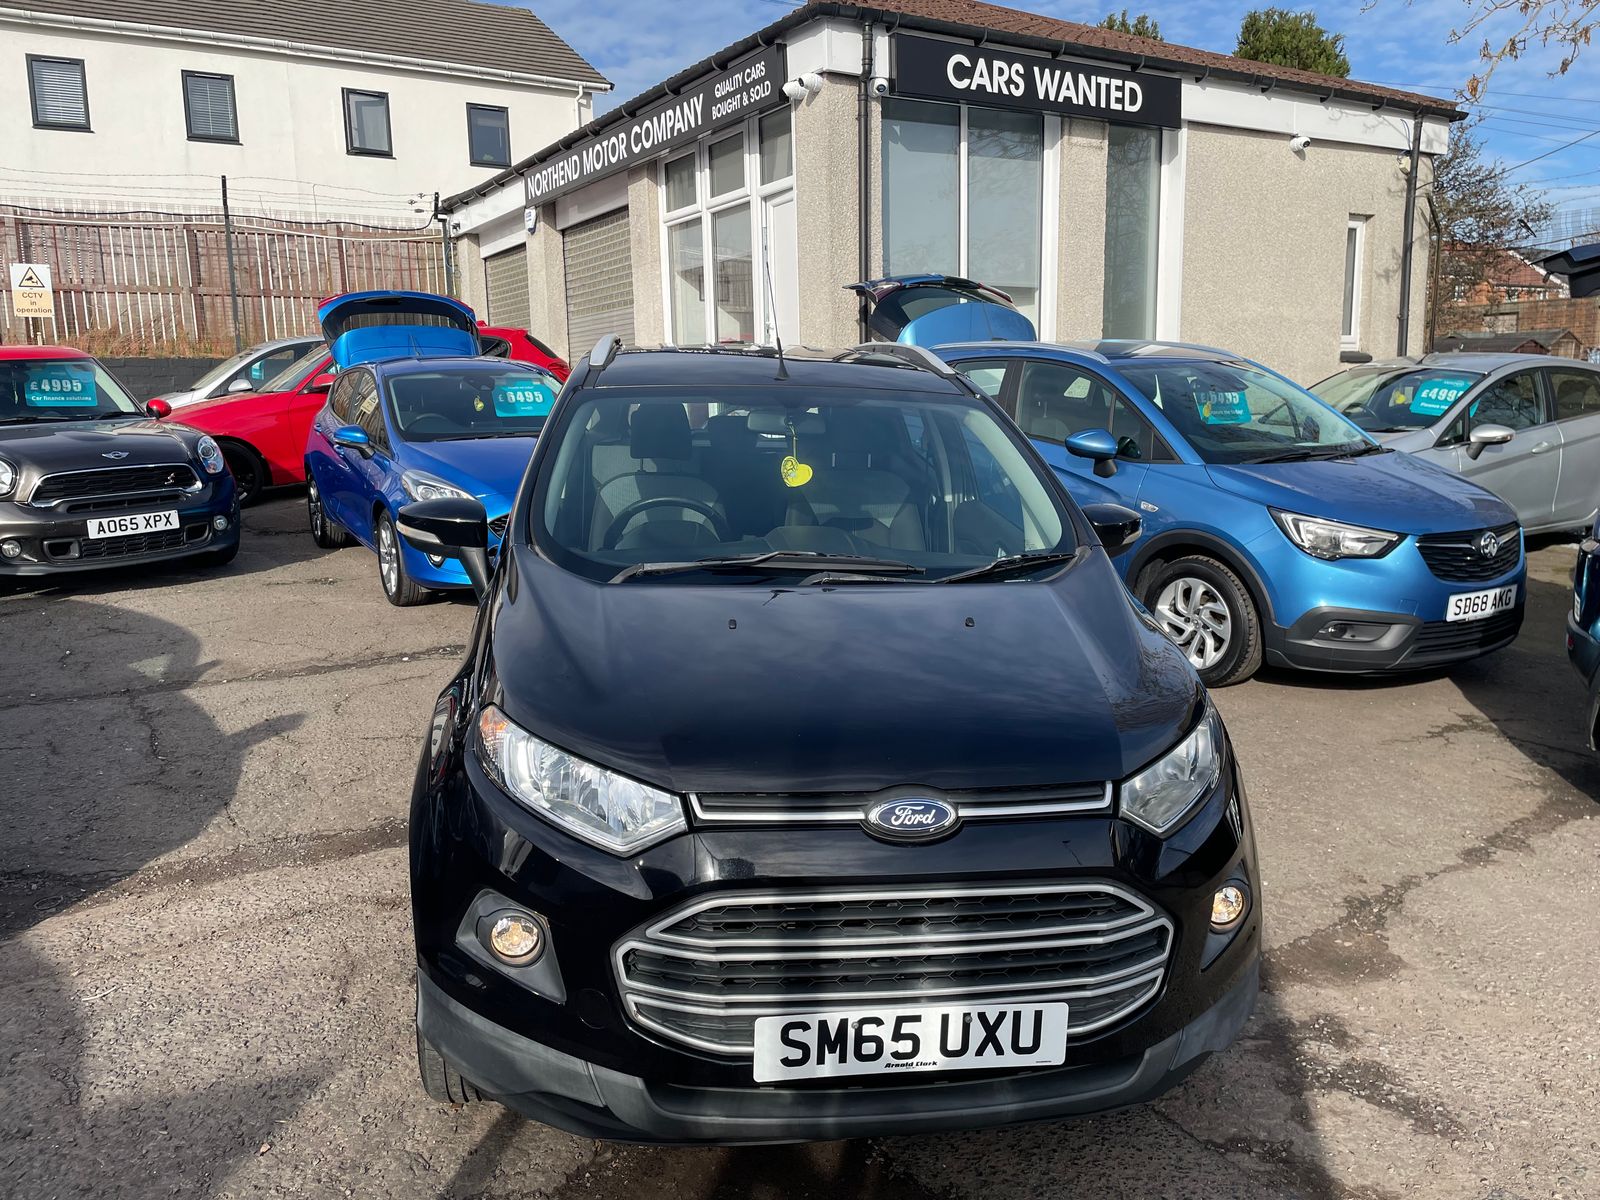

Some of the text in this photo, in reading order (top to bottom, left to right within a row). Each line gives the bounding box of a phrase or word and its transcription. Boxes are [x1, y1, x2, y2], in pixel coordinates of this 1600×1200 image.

[714, 61, 766, 98] QUALITY CARS
[946, 54, 1143, 113] CARS WANTED
[711, 81, 772, 120] BOUGHT & SOLD
[527, 93, 705, 200] NORTHEND MOTOR COMPANY
[97, 513, 173, 534] AO65 XPX
[1454, 589, 1512, 616] SD68 AKG
[891, 805, 936, 825] Ford
[779, 1010, 1043, 1067] SM65 UXU
